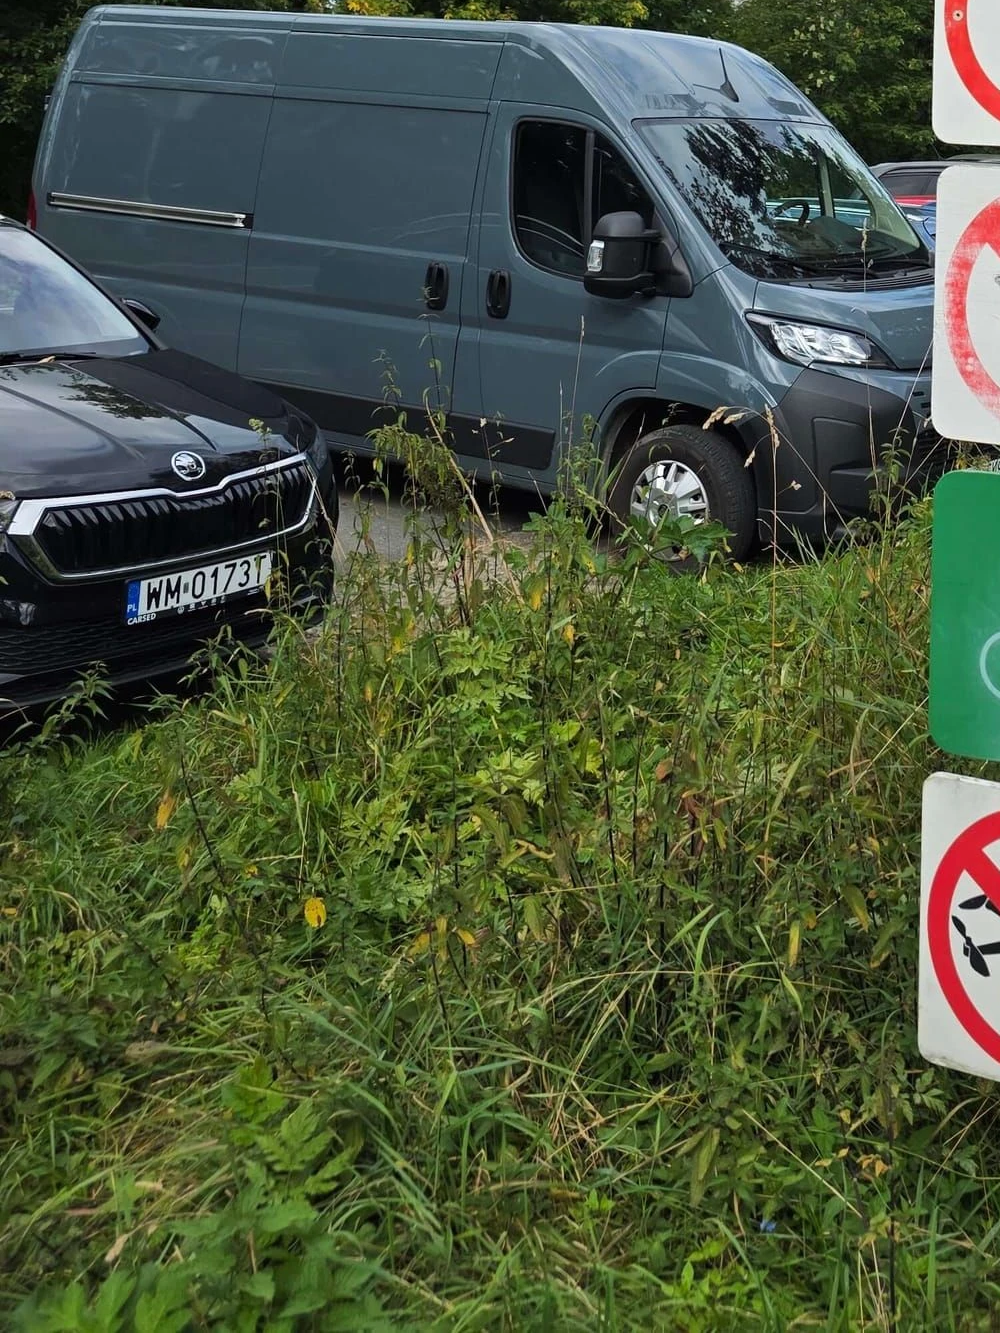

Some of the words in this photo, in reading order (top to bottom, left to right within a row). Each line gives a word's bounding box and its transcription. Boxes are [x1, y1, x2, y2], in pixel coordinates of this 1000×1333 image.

[146, 576, 182, 611] WM
[191, 554, 267, 600] 0173T
[127, 603, 137, 613] PL
[127, 612, 157, 626] CARSED
